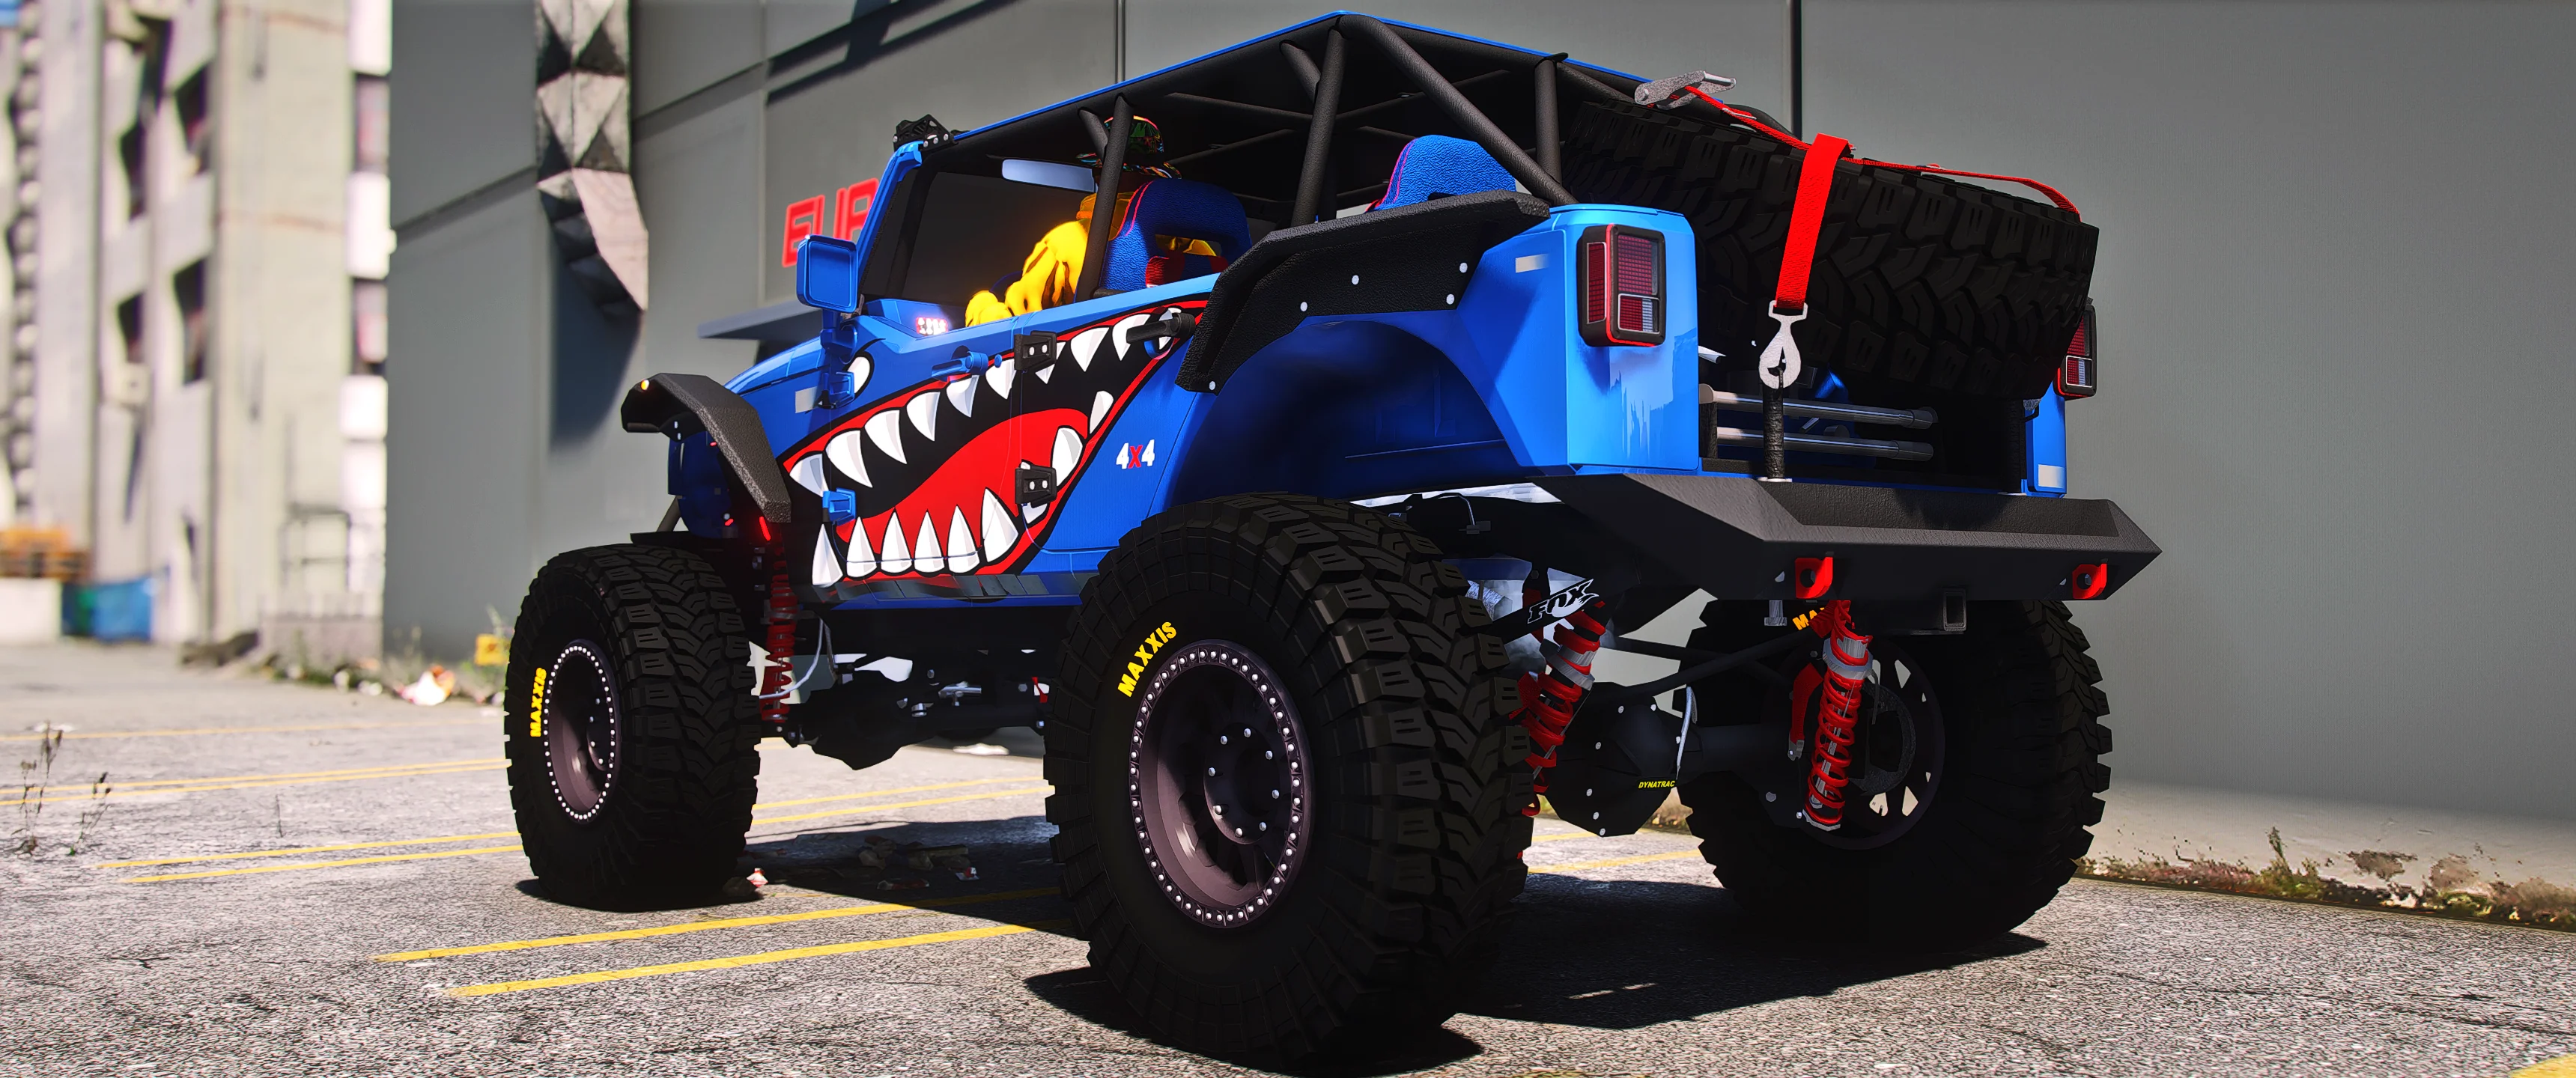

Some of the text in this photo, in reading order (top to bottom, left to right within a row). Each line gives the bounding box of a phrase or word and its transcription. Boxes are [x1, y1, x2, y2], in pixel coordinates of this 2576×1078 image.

[1527, 578, 1600, 624] FOX
[1117, 621, 1177, 698] MAXXIS
[529, 667, 547, 737] MAXXIS
[1638, 780, 1676, 789] DYNATRAC
